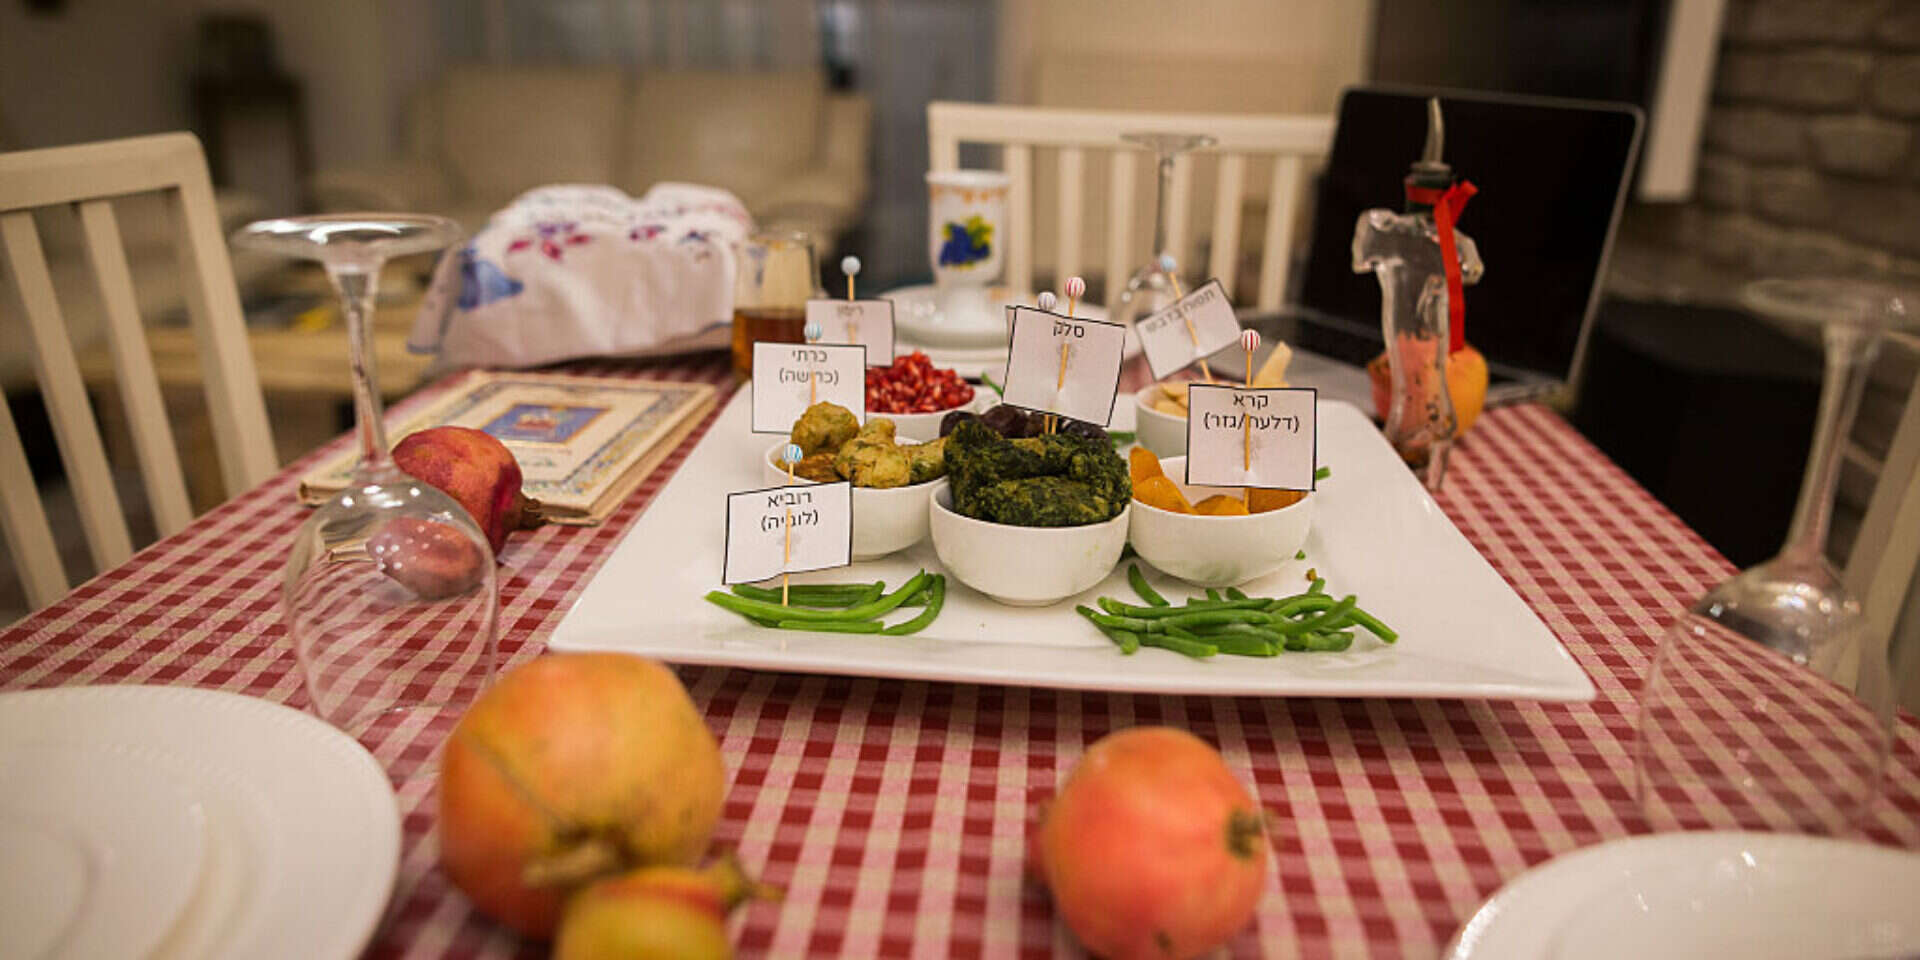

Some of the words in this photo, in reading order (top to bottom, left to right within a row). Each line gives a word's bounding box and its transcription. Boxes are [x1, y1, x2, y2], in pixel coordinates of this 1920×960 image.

[1053, 320, 1085, 338] סלק
[792, 350, 828, 363] כרתי
[779, 366, 840, 386] (כרשה)
[1233, 393, 1269, 410] קרא
[768, 491, 812, 508] רוביא
